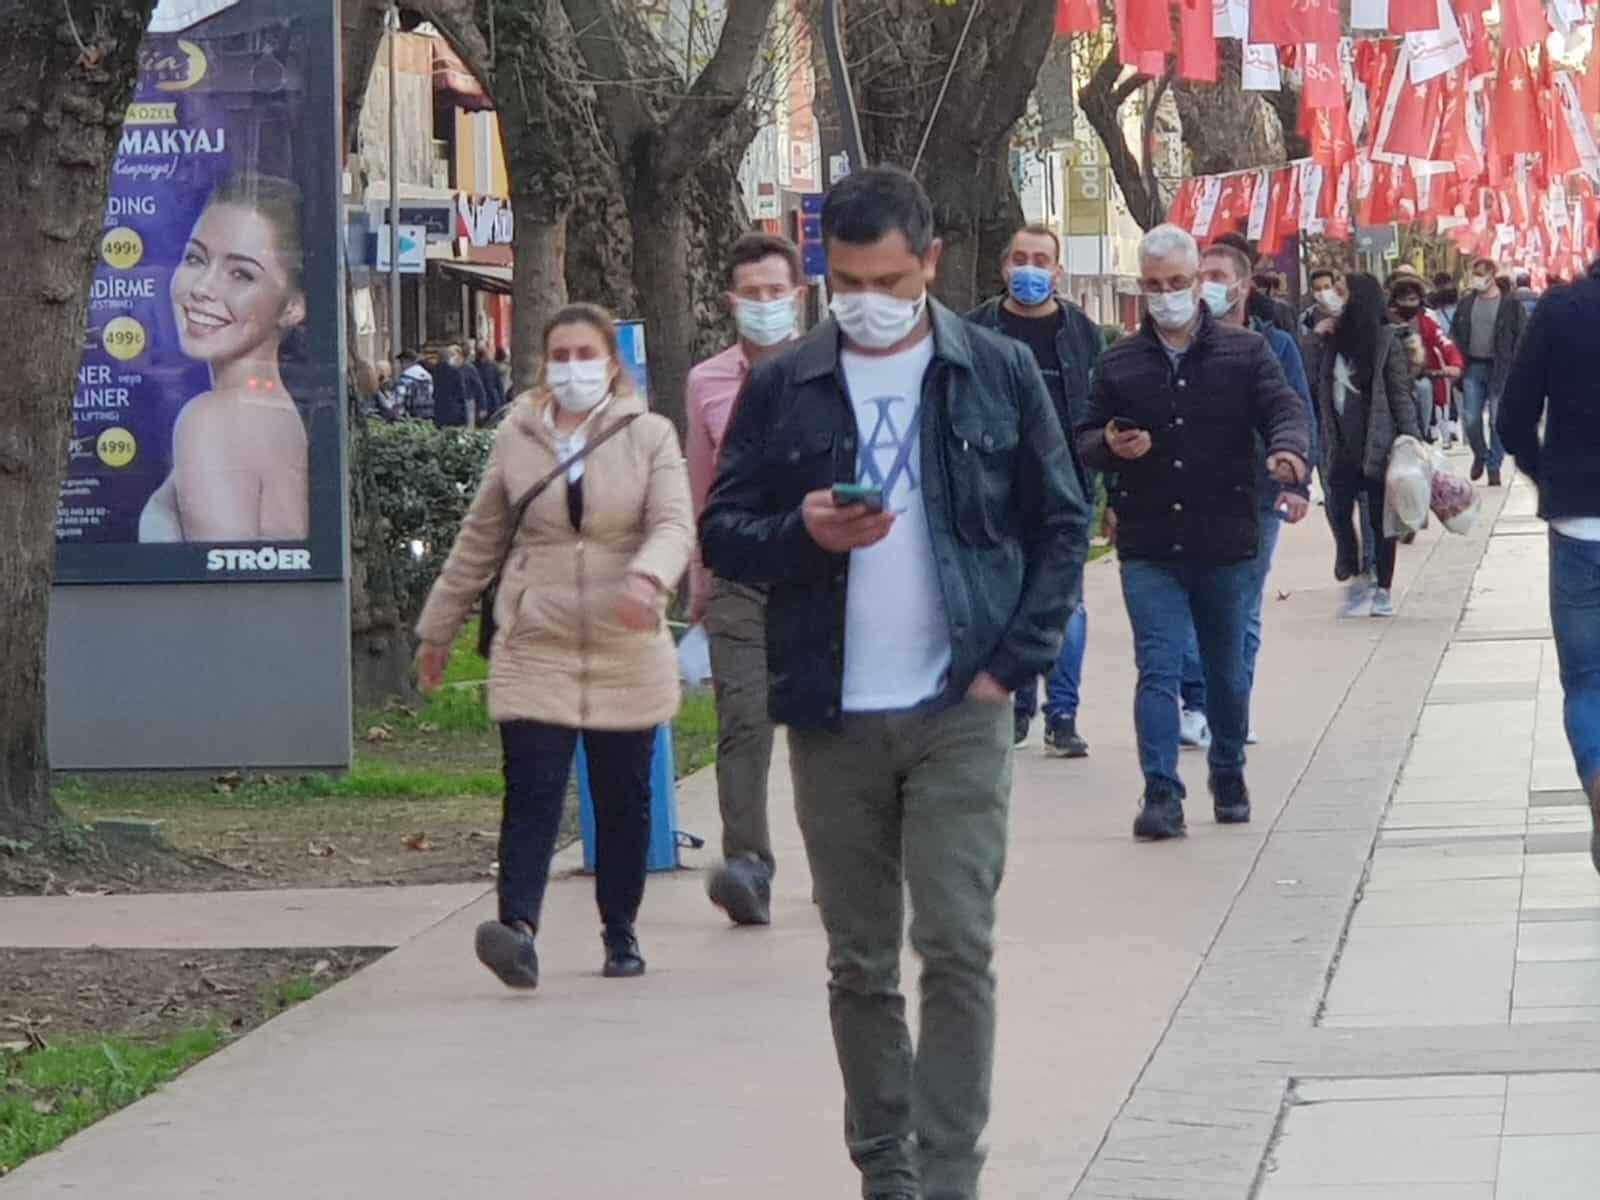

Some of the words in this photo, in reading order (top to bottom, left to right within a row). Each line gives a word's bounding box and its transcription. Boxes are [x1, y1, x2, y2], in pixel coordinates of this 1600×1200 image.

[118, 128, 225, 155] MAKYAJ
[106, 195, 156, 215] DING
[206, 546, 313, 571] STRÖER
